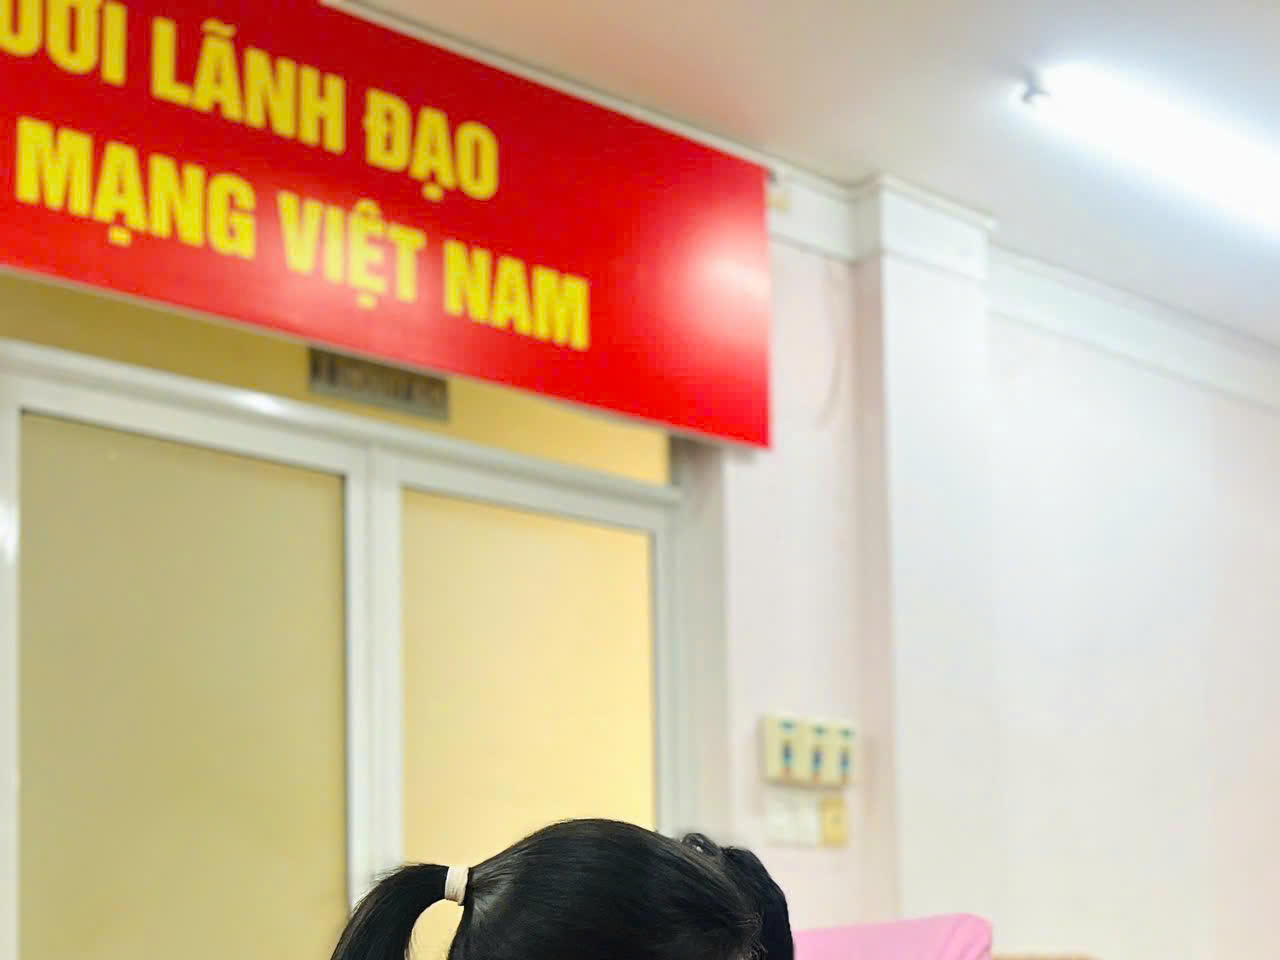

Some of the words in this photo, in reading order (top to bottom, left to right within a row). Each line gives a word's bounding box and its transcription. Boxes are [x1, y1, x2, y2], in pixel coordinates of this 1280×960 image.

[152, 17, 345, 154] LÃNH
[365, 88, 500, 202] ĐẠO
[15, 115, 257, 260] MẠNG
[277, 190, 426, 310] VIỆT
[444, 240, 590, 349] NAM
